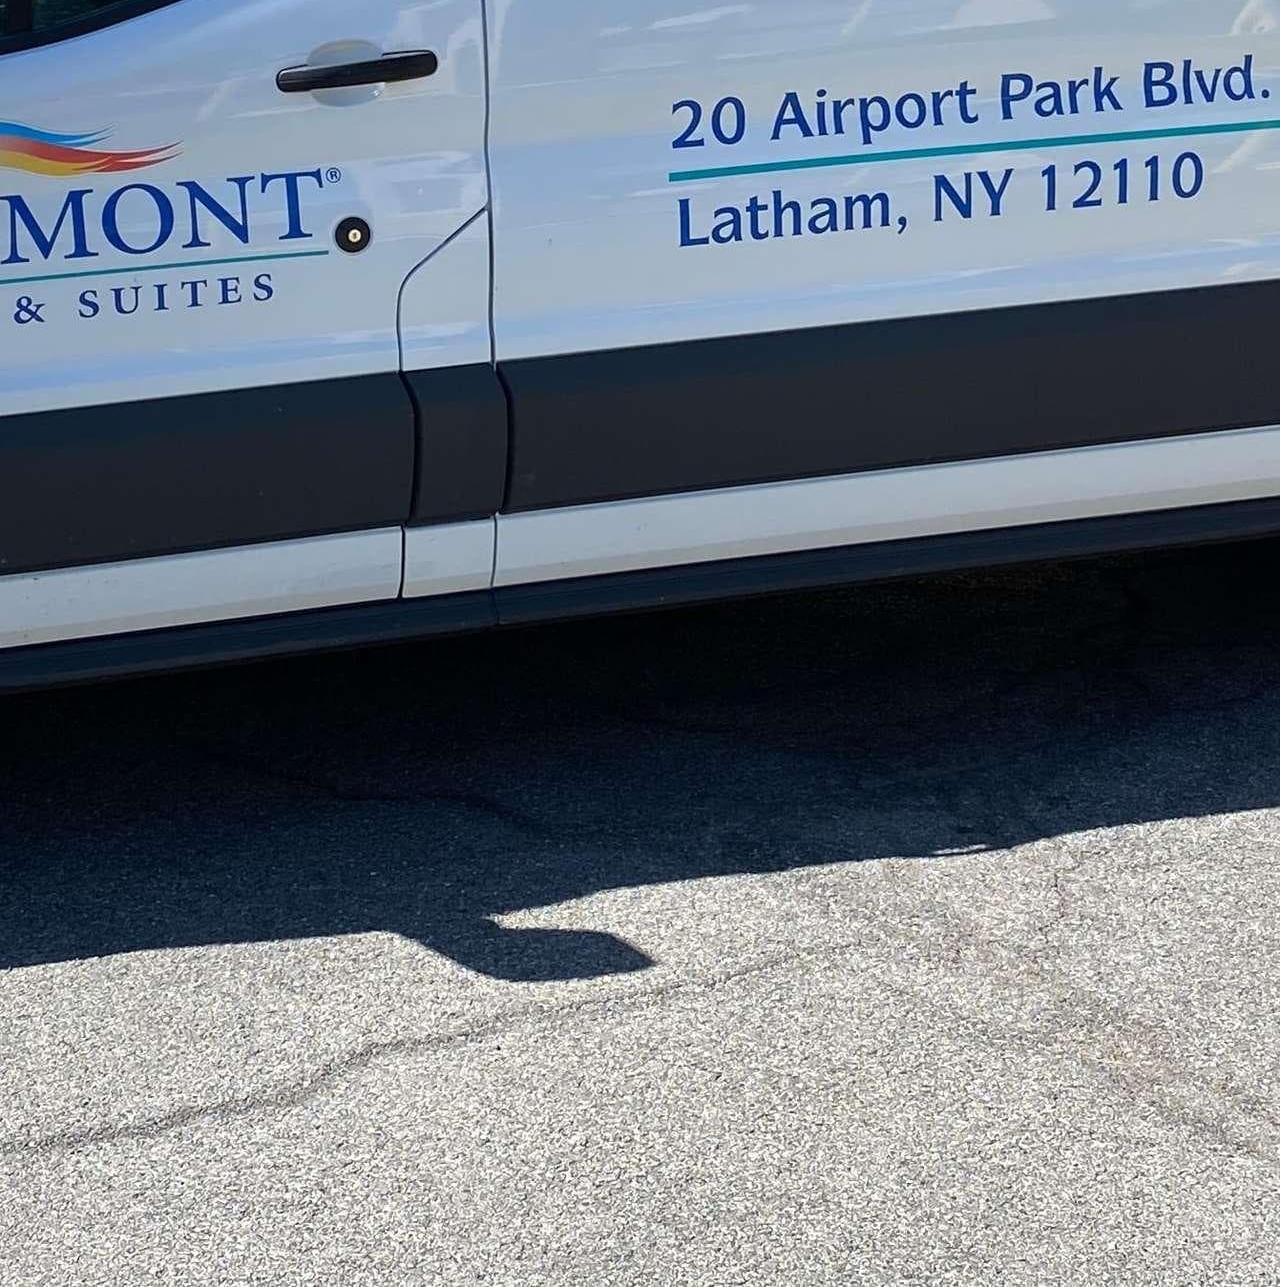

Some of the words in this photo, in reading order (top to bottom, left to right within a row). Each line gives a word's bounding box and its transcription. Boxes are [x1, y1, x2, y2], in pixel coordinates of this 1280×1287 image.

[671, 96, 746, 150] 20
[770, 80, 979, 146] Airport
[1000, 66, 1124, 121] Park
[1143, 54, 1271, 109] Blvd.
[677, 189, 908, 247] Latham,
[933, 168, 1014, 222] NY
[1041, 151, 1204, 211] 12110
[13, 295, 46, 325] &
[78, 273, 275, 319] SUITES
